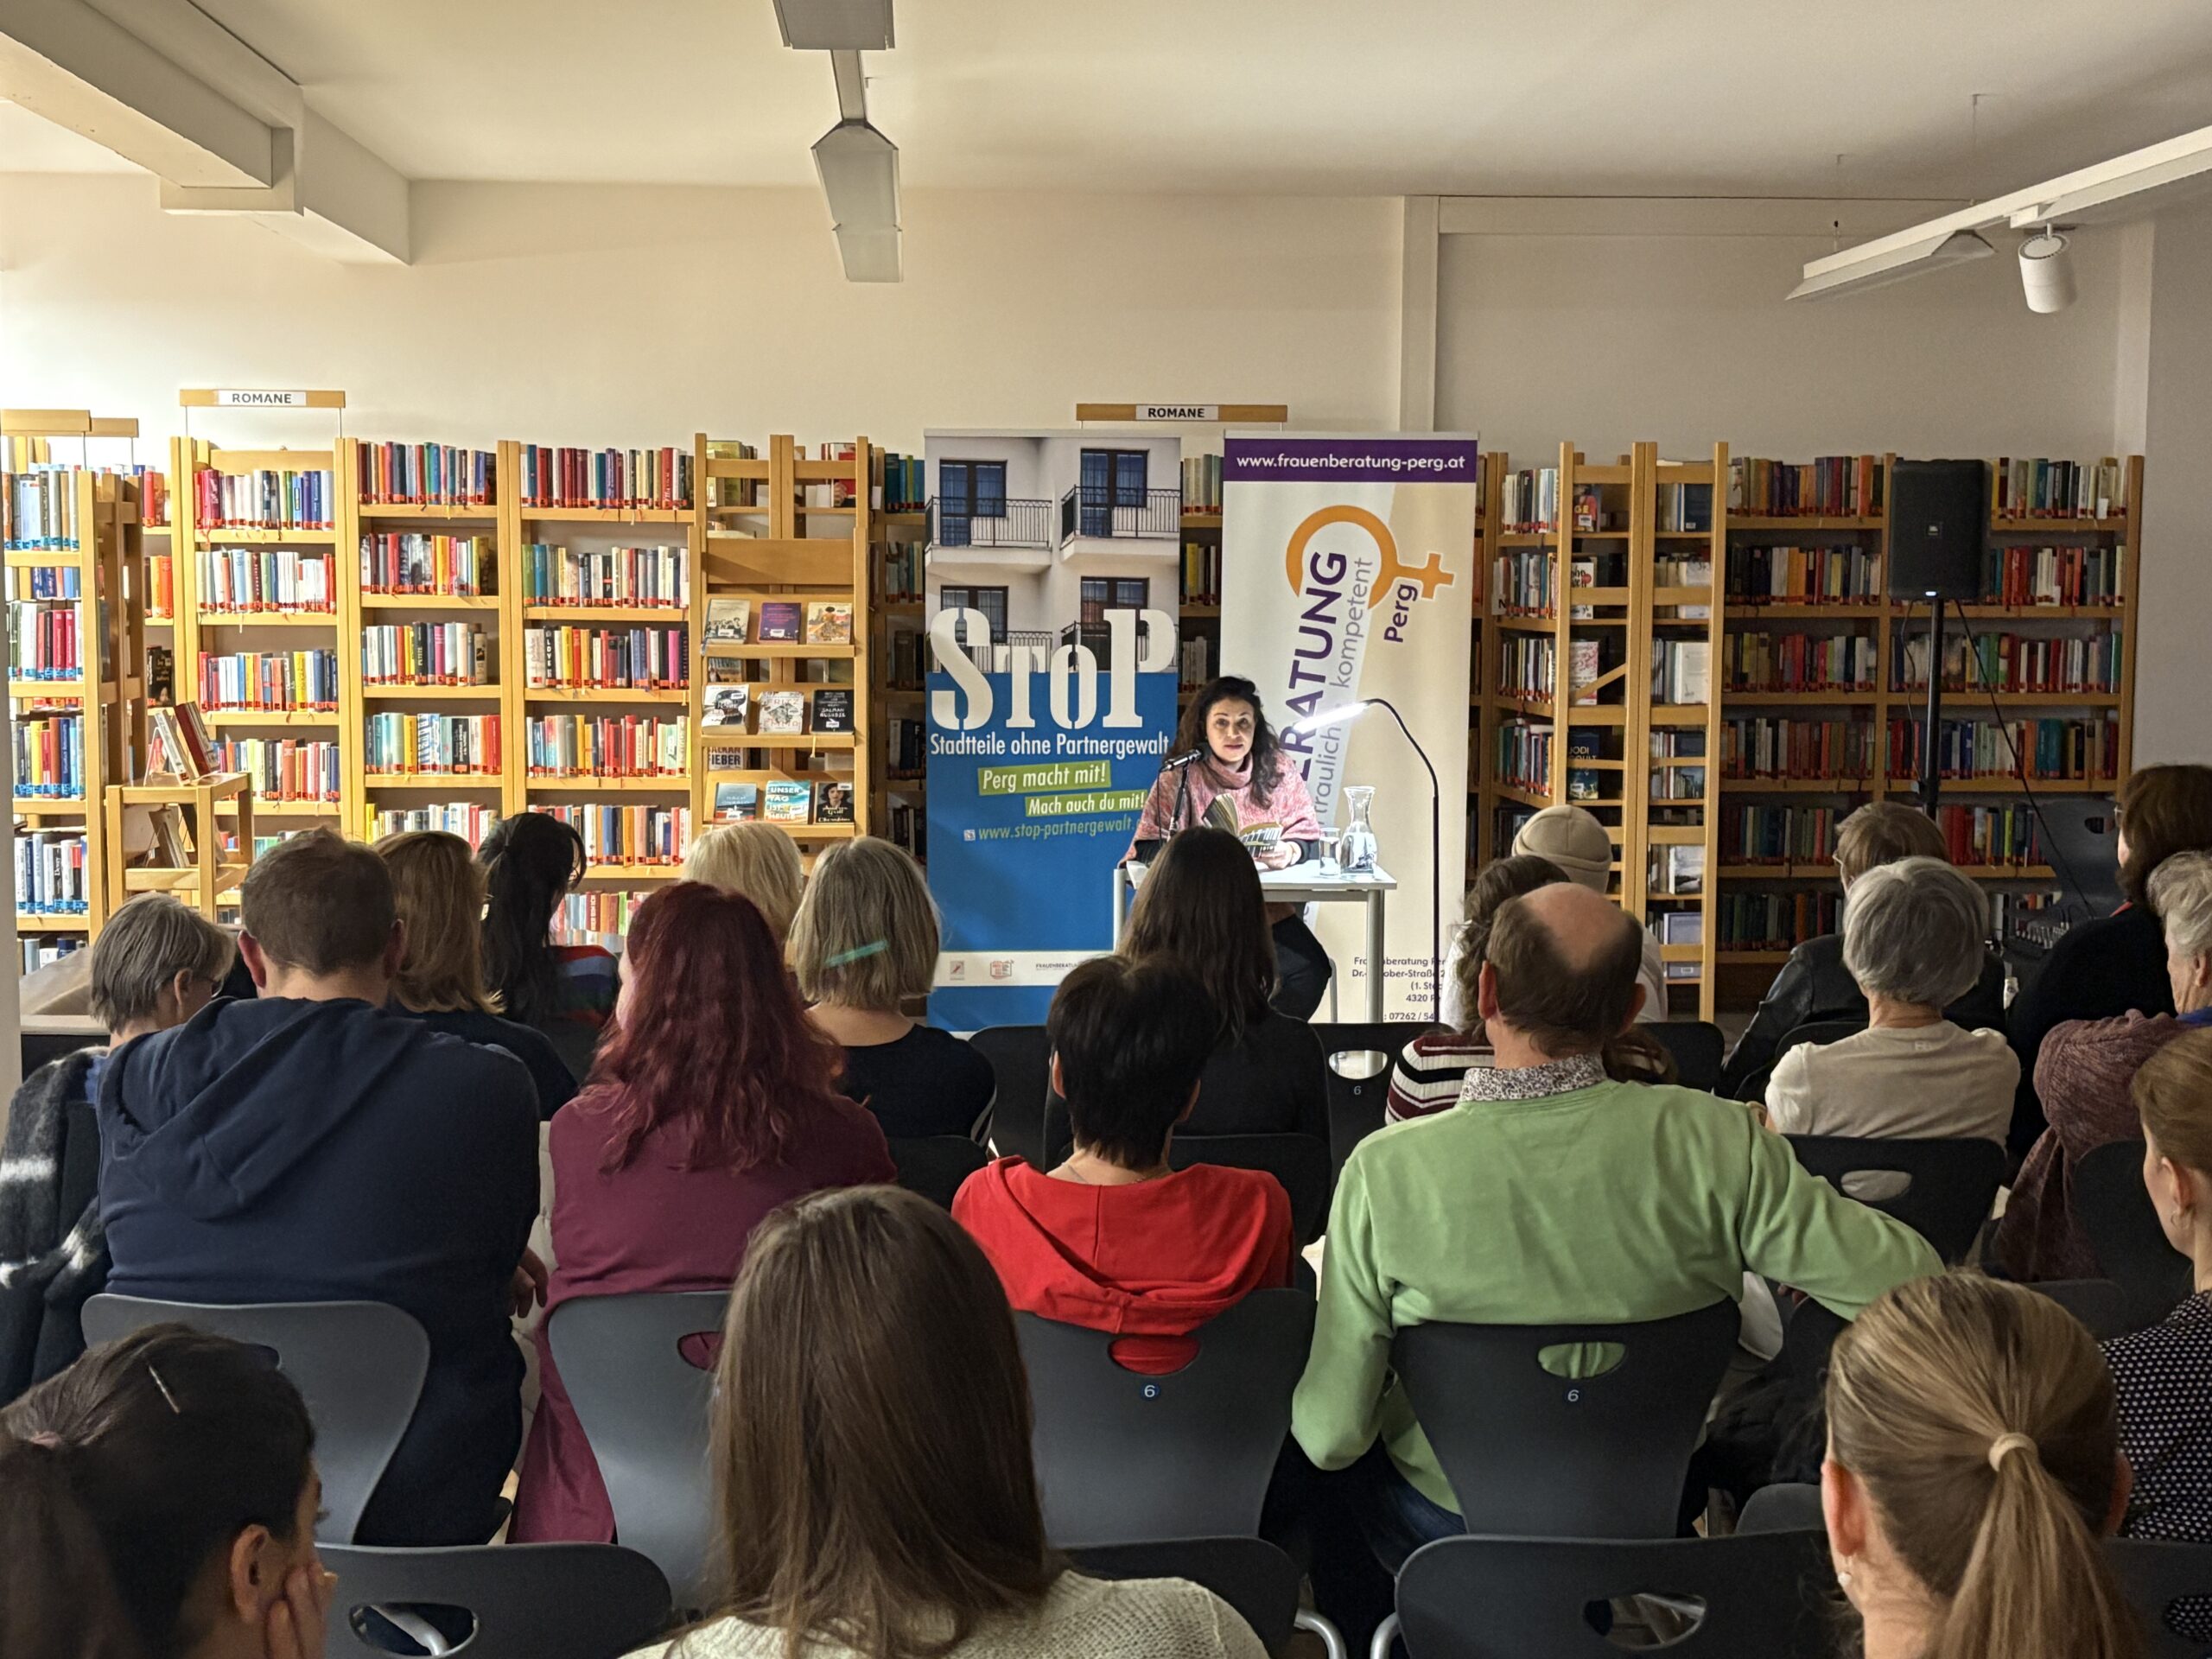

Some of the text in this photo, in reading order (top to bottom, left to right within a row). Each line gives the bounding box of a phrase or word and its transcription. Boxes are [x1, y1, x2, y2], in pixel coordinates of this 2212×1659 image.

[232, 393, 292, 404] ROMANE
[1147, 408, 1205, 418] ROMANE
[1236, 453, 1466, 472] www.frauenberatung-perg.at
[1383, 583, 1419, 643] Perg
[1329, 557, 1374, 689] kompetent
[930, 731, 1169, 760] Stadtteile ohne Partnergewalt
[709, 754, 741, 766] IEBER
[982, 762, 1106, 793] Perg macht mit!
[1028, 791, 1145, 816] Mach auch du mit!
[1406, 994, 1427, 1002] 4320
[1389, 1012, 1416, 1020] 07262
[1354, 1085, 1362, 1096] 6
[1144, 1384, 1155, 1398] 6
[1567, 1389, 1580, 1402] 6
